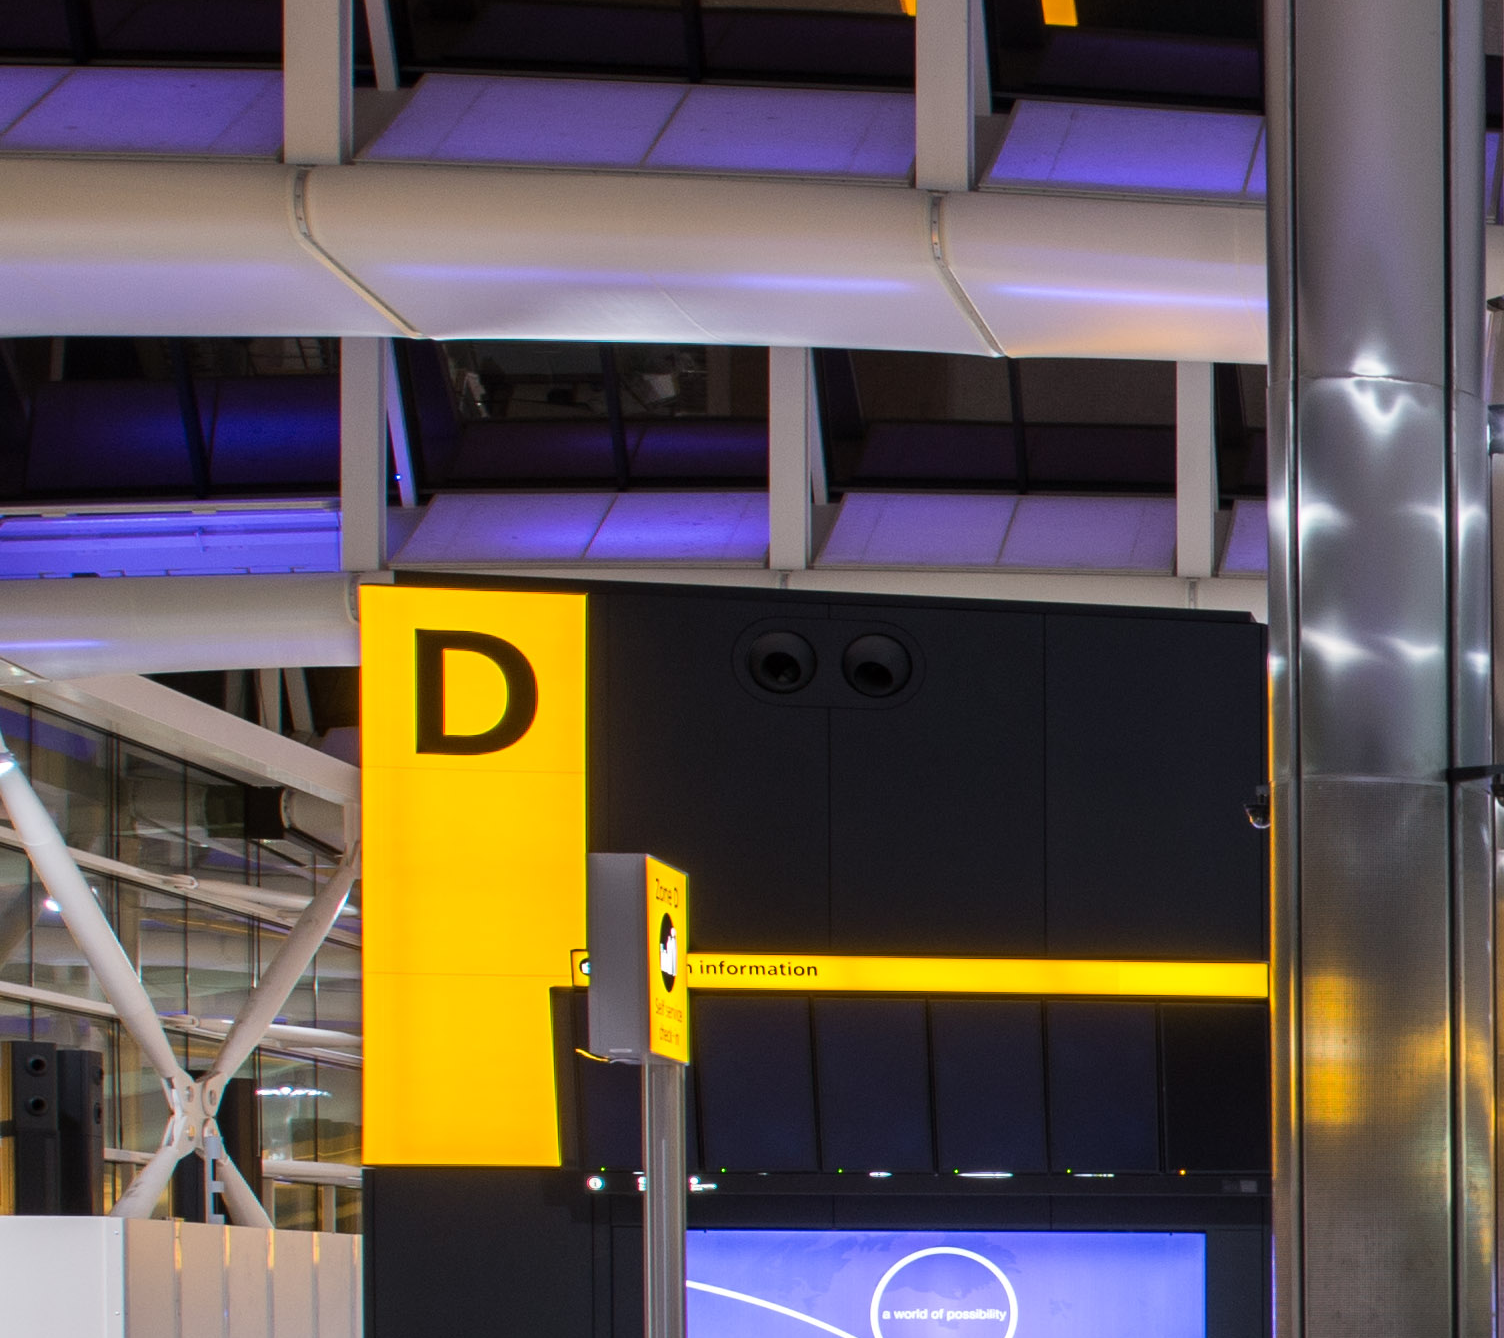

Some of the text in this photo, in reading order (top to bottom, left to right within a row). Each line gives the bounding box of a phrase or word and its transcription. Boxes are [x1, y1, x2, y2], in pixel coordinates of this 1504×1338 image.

[414, 628, 539, 756] D
[655, 878, 680, 909] Zone D
[699, 959, 819, 977] information
[881, 1308, 1007, 1322] a world of possibility
